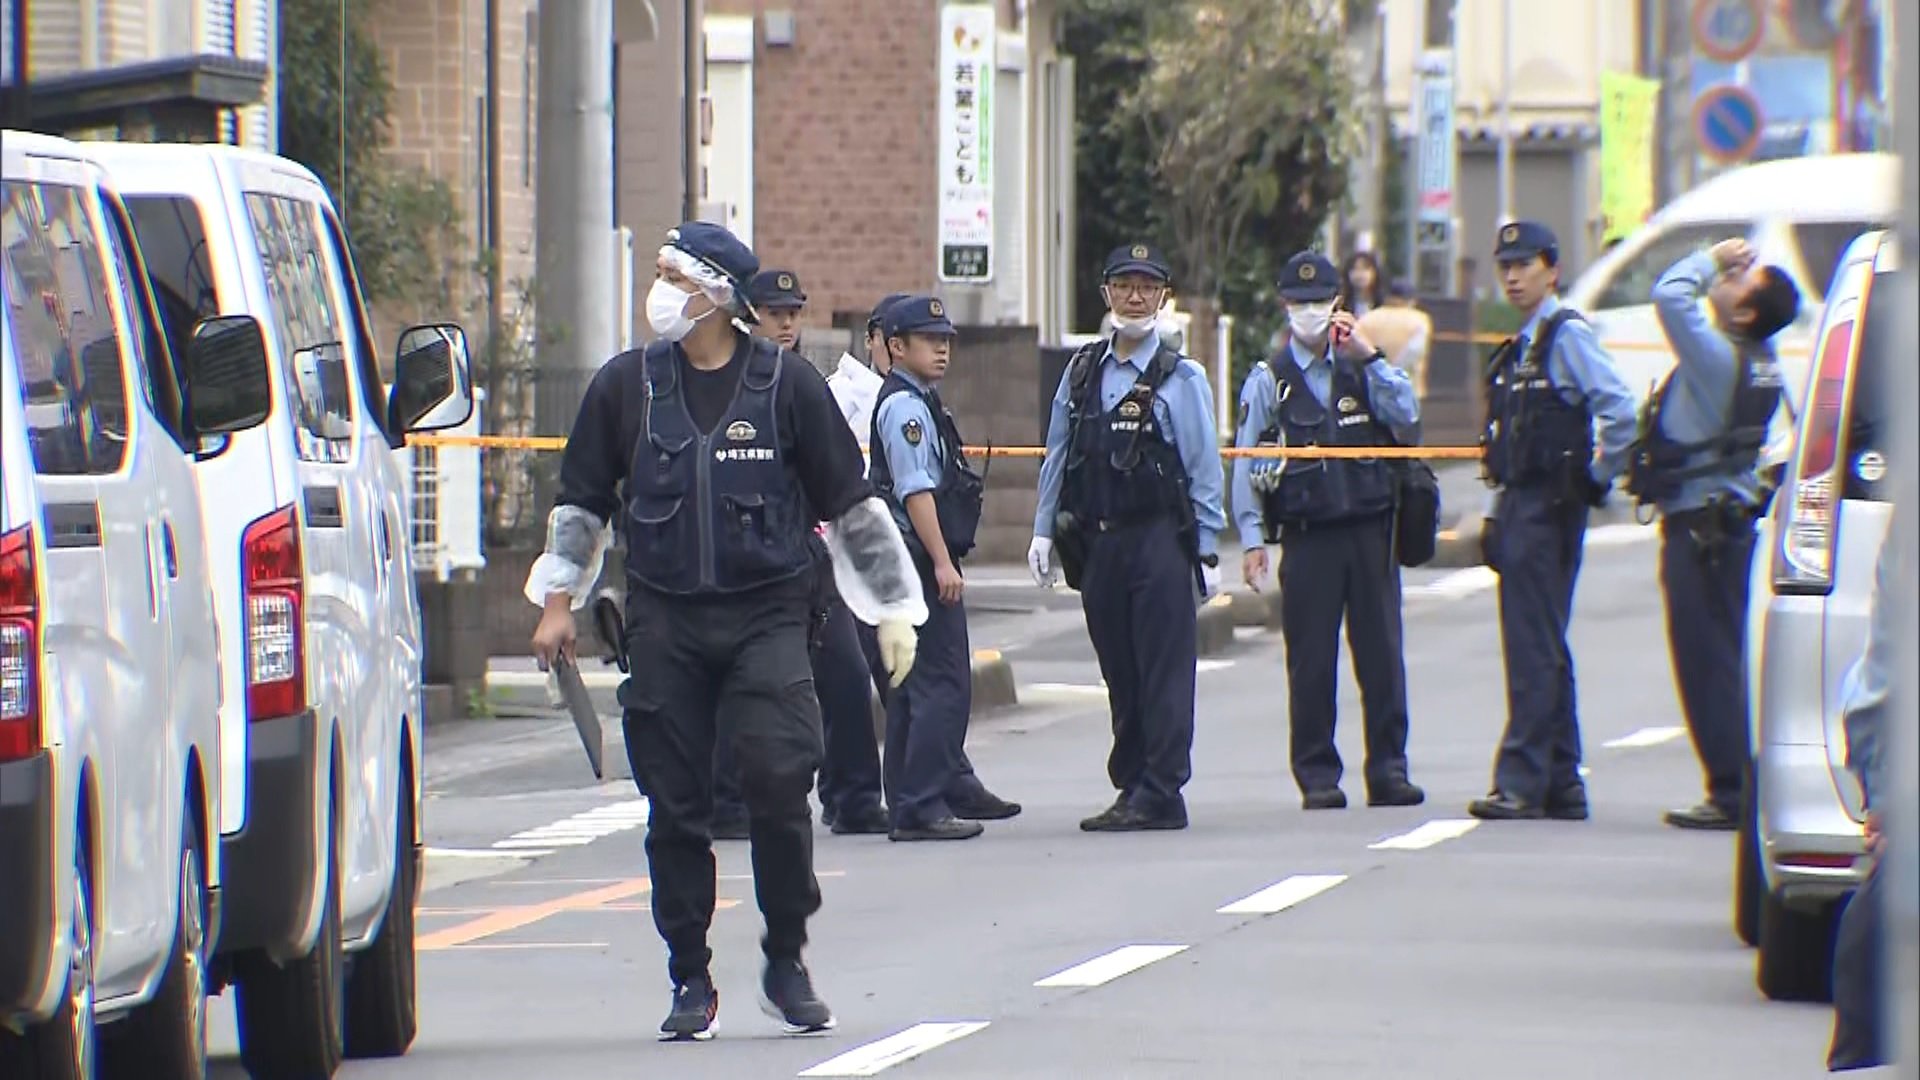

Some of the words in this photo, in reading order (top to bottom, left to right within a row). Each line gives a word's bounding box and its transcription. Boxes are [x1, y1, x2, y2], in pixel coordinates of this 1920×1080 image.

[727, 448, 775, 461] 埼玉県警察
